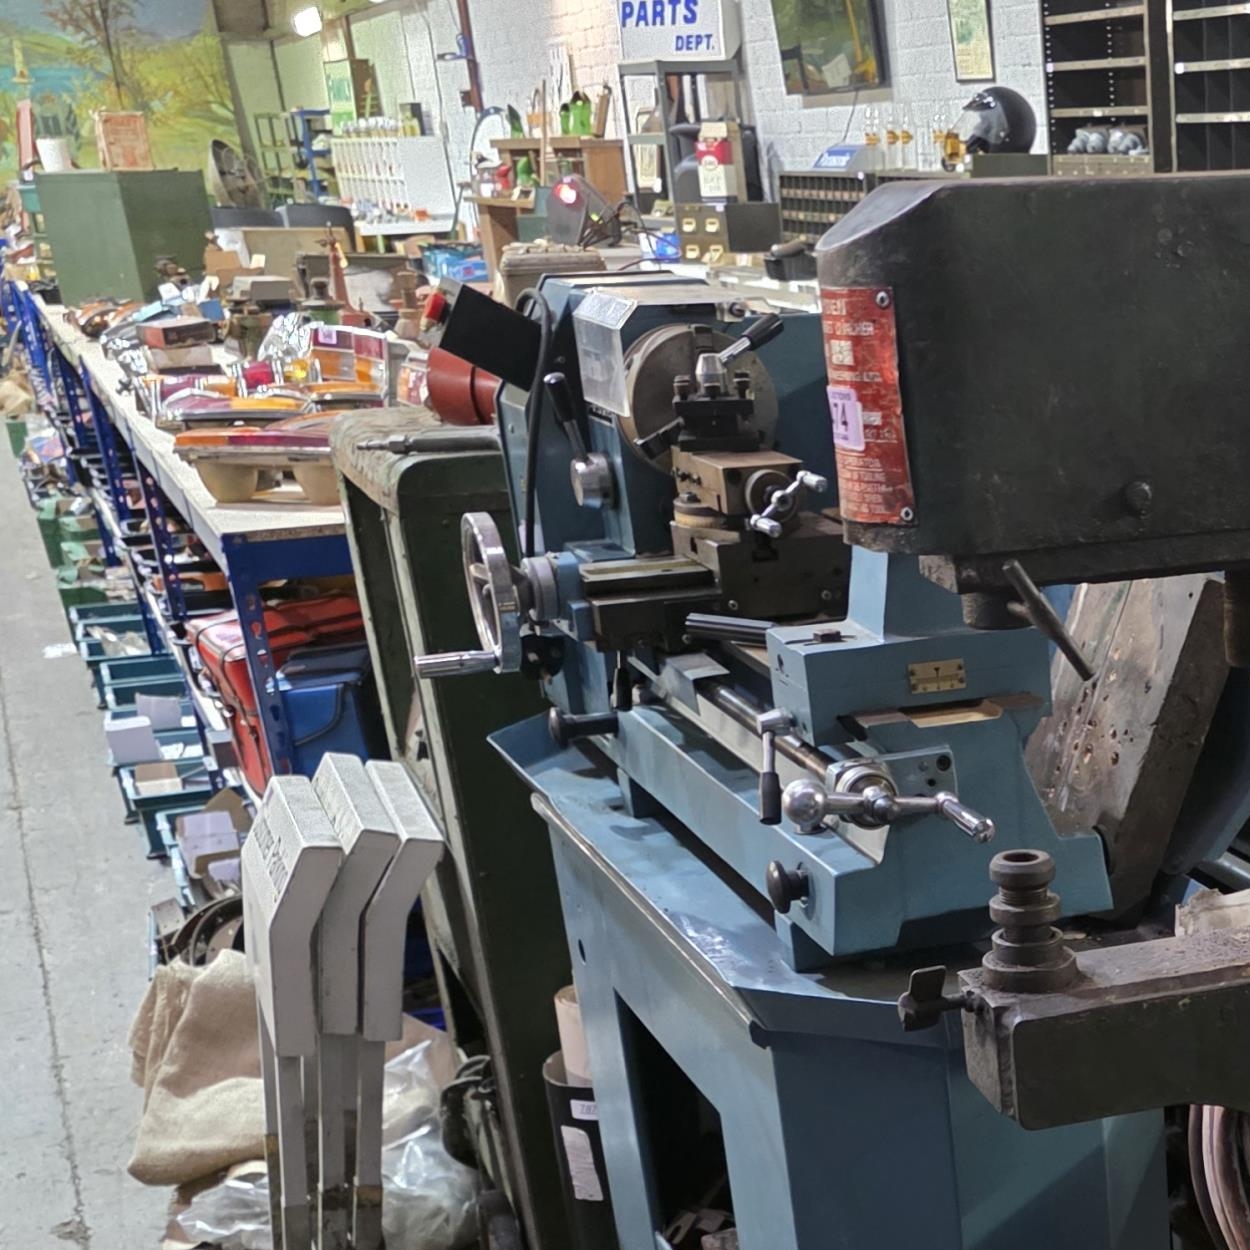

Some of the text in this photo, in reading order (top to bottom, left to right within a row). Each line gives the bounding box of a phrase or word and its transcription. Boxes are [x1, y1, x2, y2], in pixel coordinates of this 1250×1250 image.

[621, 0, 698, 27] PARTS
[675, 34, 715, 51] DEPT.
[831, 402, 849, 433] 74
